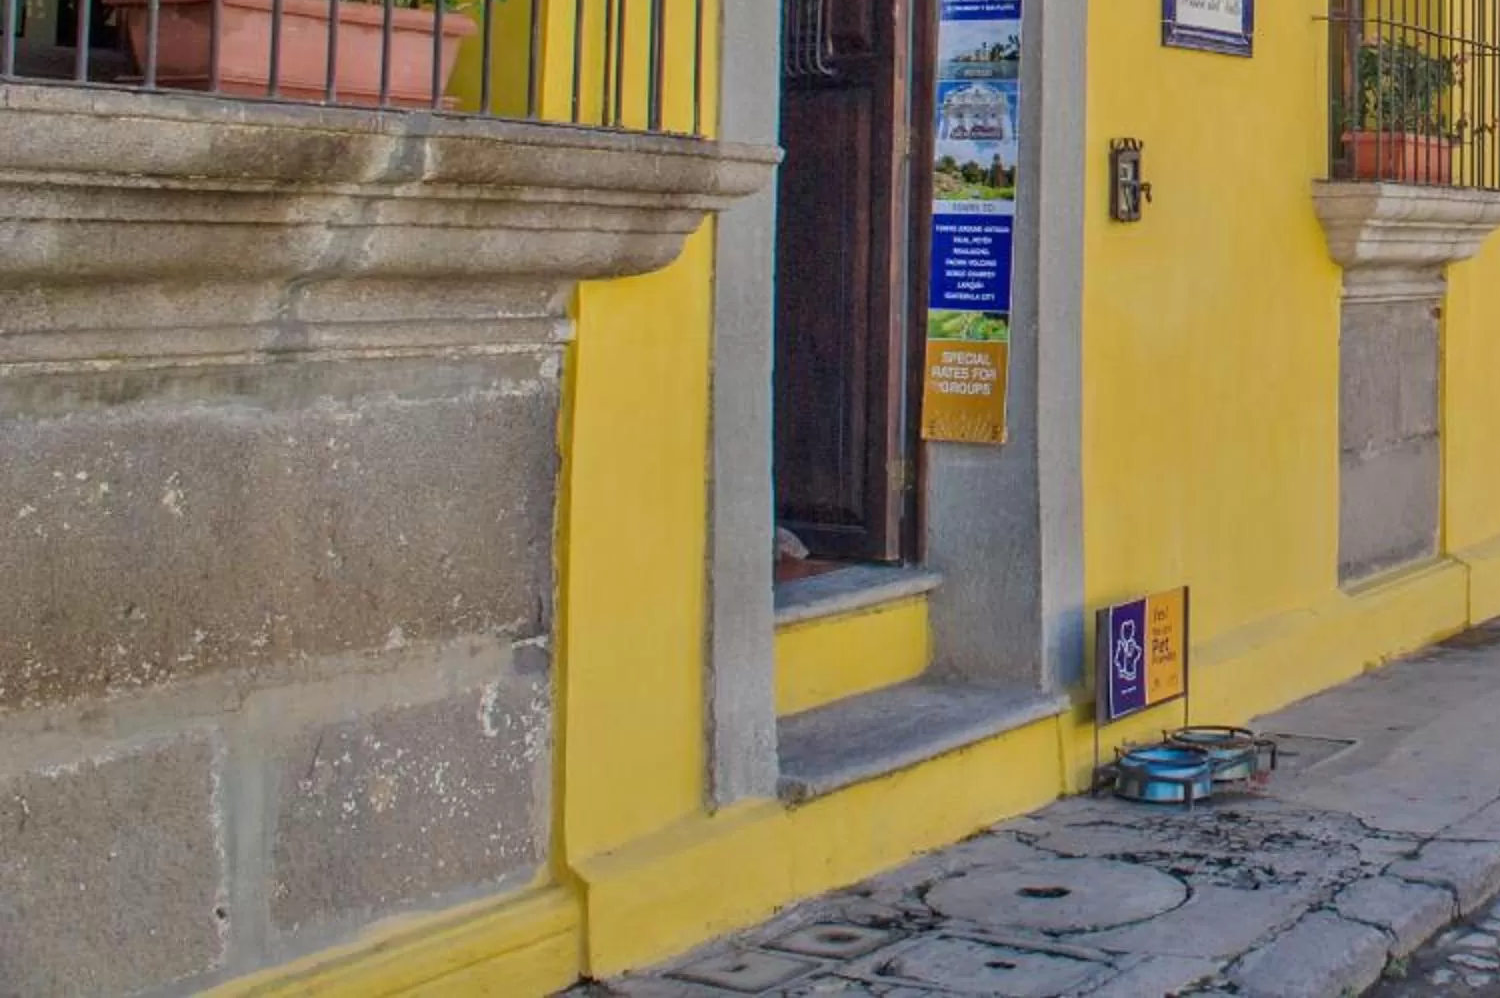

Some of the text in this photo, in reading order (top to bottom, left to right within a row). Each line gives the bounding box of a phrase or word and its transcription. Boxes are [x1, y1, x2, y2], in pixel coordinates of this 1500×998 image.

[941, 351, 992, 366] SPECIAL
[931, 366, 997, 380] RATES FOR
[937, 381, 992, 395] GROUPS
